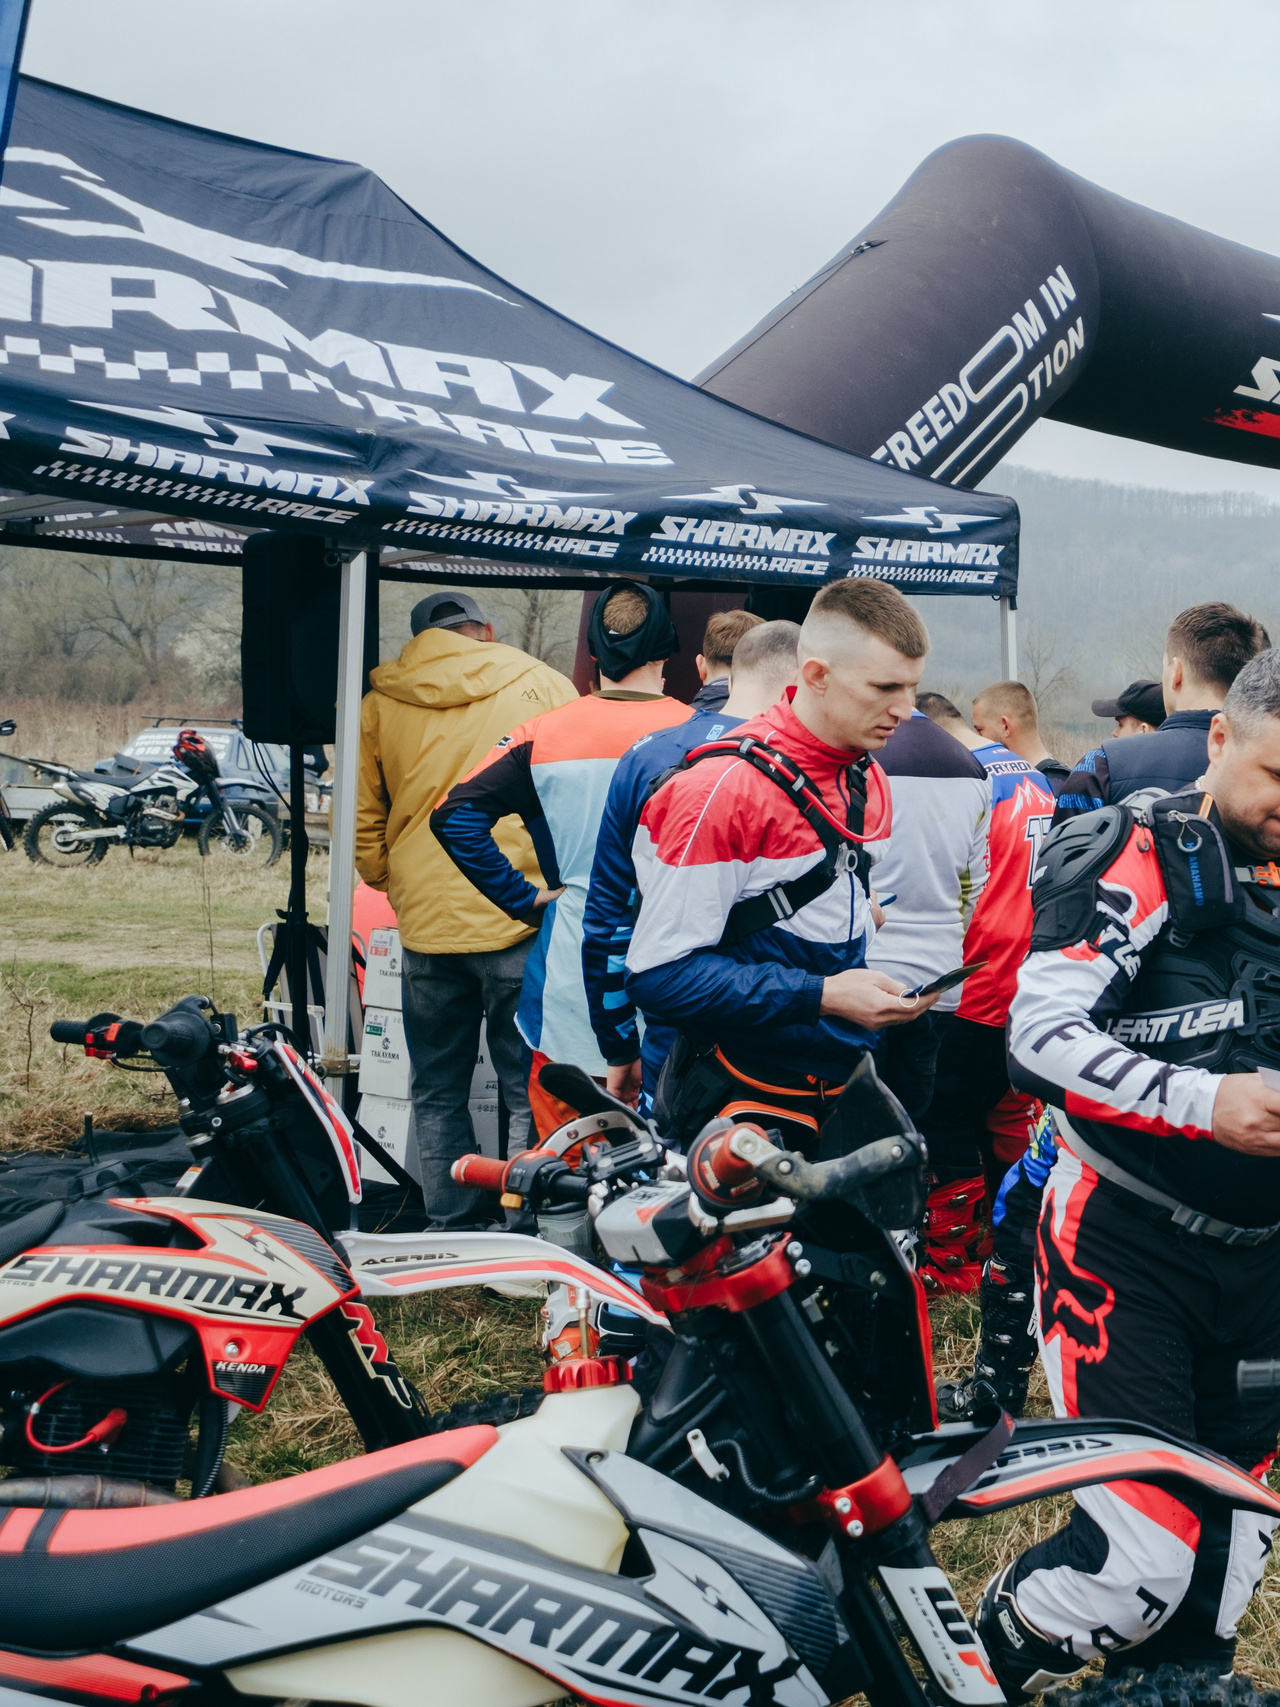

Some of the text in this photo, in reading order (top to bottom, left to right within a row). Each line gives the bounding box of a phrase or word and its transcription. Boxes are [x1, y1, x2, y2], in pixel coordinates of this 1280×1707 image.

[1039, 264, 1077, 320] IN
[0, 255, 647, 429] RMAX
[357, 390, 675, 465] RACE
[59, 426, 375, 505] SHARMAX
[252, 497, 360, 525] RACE
[406, 491, 639, 535] SHARMAX
[542, 535, 620, 558] RACE
[650, 515, 837, 556] SHARMAX
[851, 536, 1005, 567] SHARMAX
[768, 557, 829, 576] RACE
[948, 569, 998, 585] RACE
[371, 1050, 400, 1060] TAKAYAMA
[1031, 1020, 1170, 1106] FOX
[360, 1252, 460, 1266] ACERBIS
[2, 1254, 308, 1320] SHARMAX
[215, 1360, 266, 1375] KENDA
[295, 1578, 370, 1610] MOTORS
[307, 1532, 804, 1706] SHARMAX
